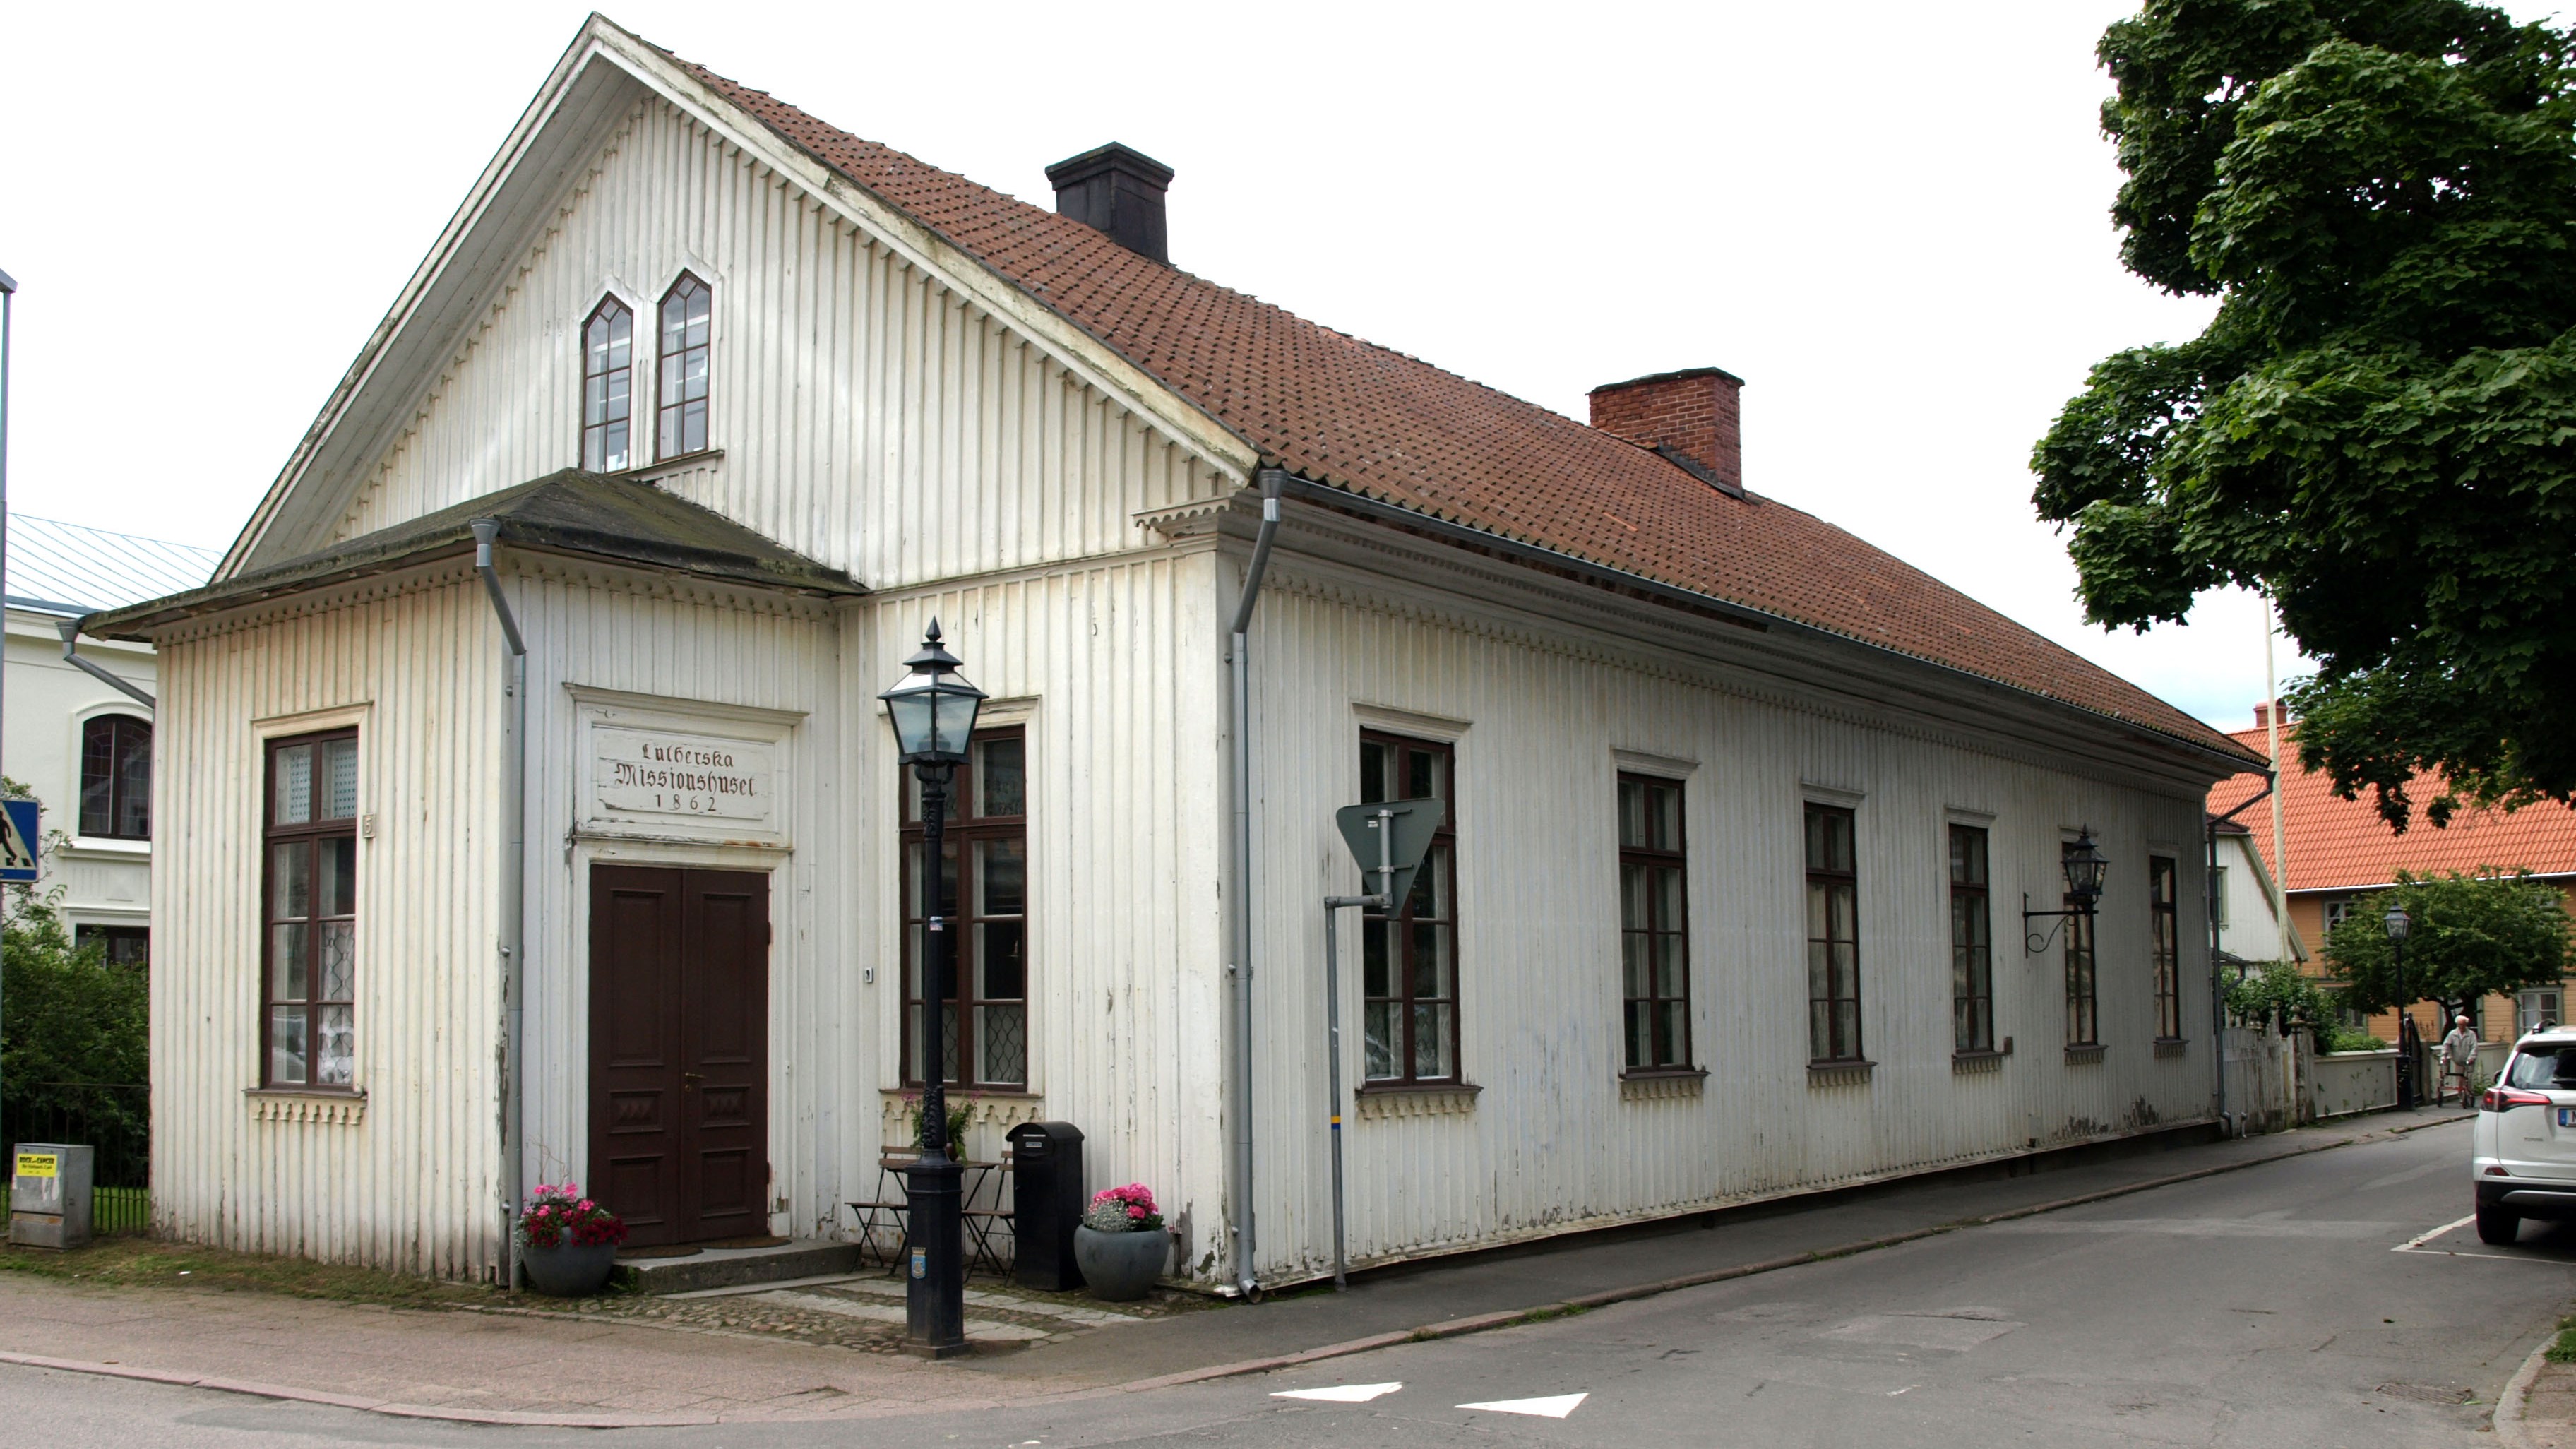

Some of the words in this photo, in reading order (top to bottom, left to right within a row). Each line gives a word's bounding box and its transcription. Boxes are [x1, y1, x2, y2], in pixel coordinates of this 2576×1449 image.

[642, 743, 734, 768] Lutherska
[614, 762, 756, 797] Missionshuset
[654, 794, 717, 811] 1862
[364, 816, 373, 834] 5
